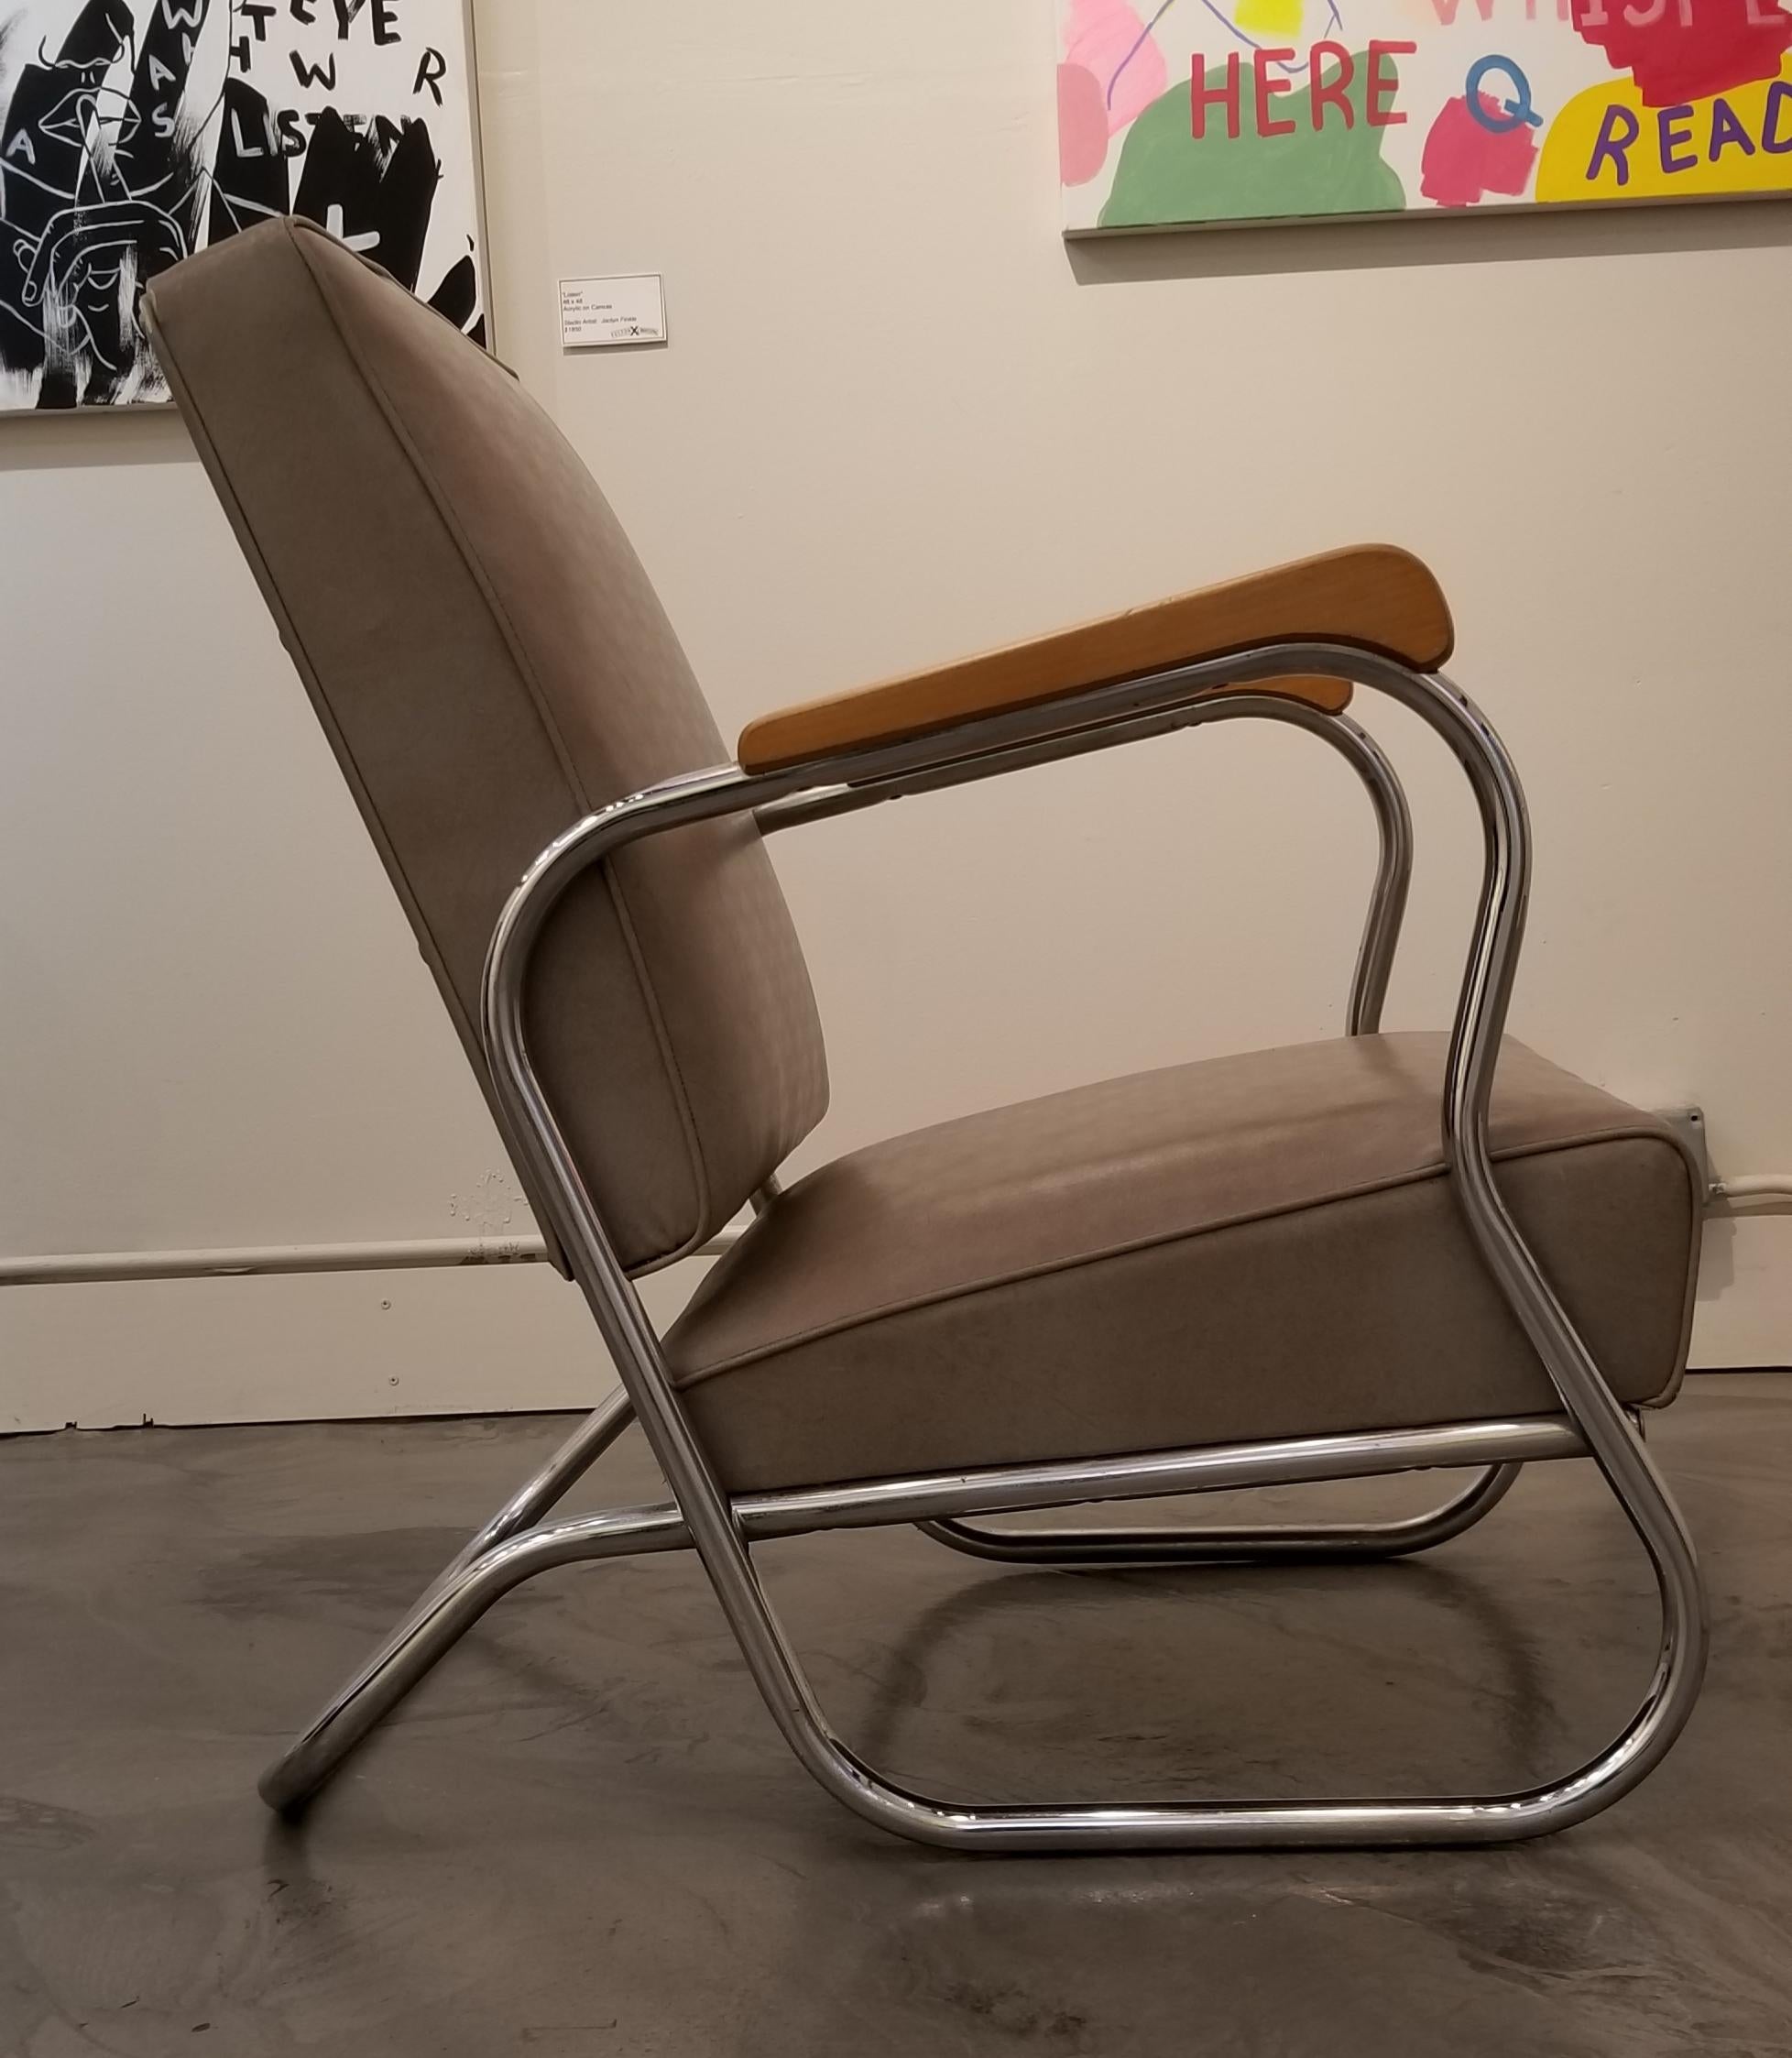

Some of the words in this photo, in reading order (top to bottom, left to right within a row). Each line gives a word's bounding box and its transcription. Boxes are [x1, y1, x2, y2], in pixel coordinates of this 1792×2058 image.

[412, 47, 446, 107] R
[1191, 39, 1417, 140] HERE
[1466, 54, 1544, 135] Q
[5, 128, 36, 165] A
